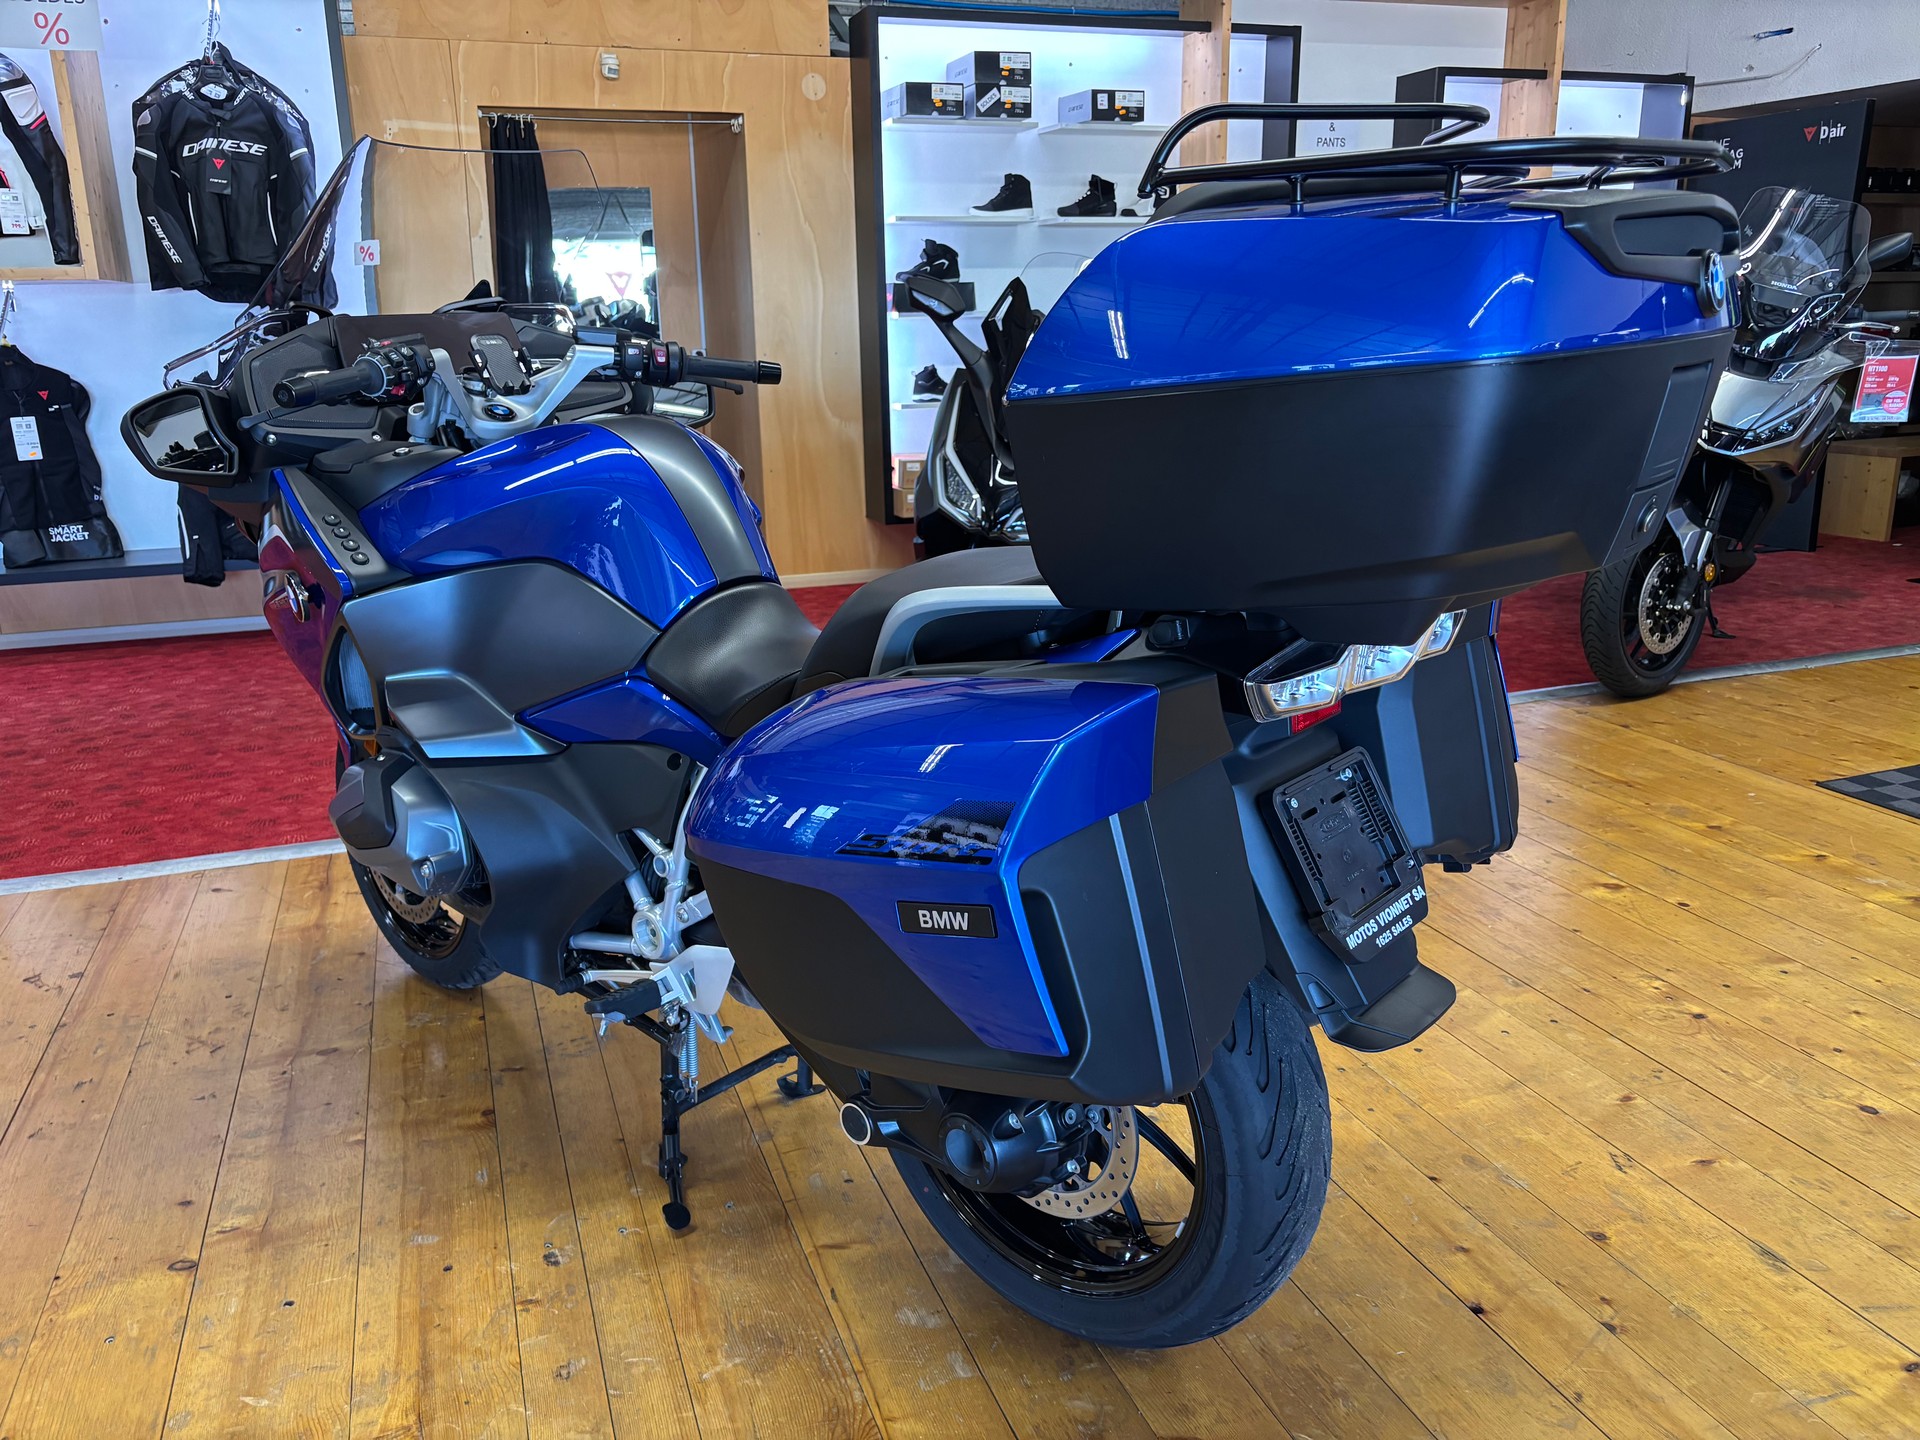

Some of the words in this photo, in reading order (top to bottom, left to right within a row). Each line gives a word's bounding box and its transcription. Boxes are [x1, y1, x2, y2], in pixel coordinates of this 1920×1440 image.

[33, 12, 70, 45] %
[1329, 122, 1336, 132] &
[182, 137, 268, 157] DAINESE
[1316, 137, 1346, 148] PANTS
[147, 216, 183, 264] DAINESE
[359, 245, 375, 262] %
[1770, 280, 1798, 291] HONDA
[48, 525, 84, 535] SMART
[50, 531, 90, 542] JACKET
[917, 909, 969, 931] BMW
[1345, 919, 1379, 950] MOTOS
[1375, 892, 1413, 927] VIONNET
[1412, 885, 1426, 902] SA
[1375, 930, 1393, 948] 1625
[1391, 914, 1413, 937] SALES
